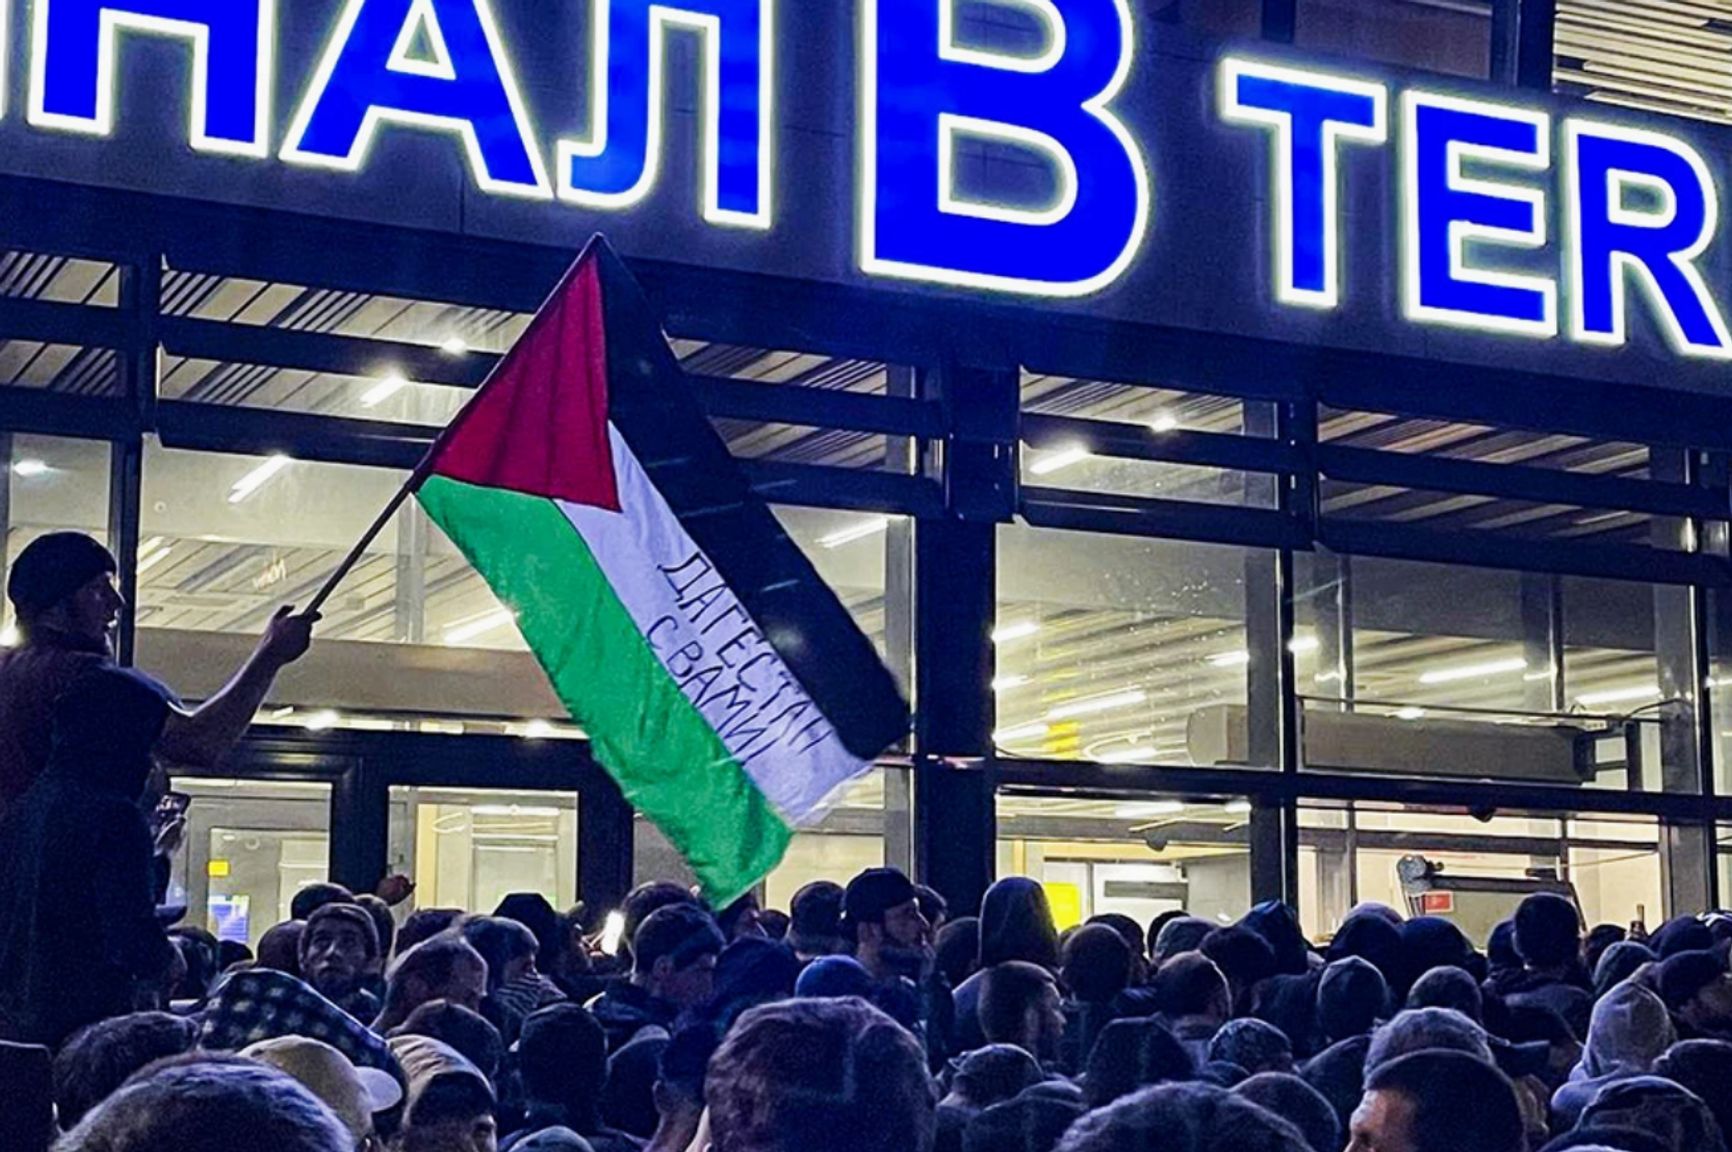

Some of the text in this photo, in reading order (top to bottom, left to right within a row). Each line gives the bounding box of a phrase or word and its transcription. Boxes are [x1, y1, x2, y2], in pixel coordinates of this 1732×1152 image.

[0, 0, 772, 229] НАЛ
[656, 551, 833, 755] ДАГЕСТАН
[666, 640, 778, 766] ВАМИ
